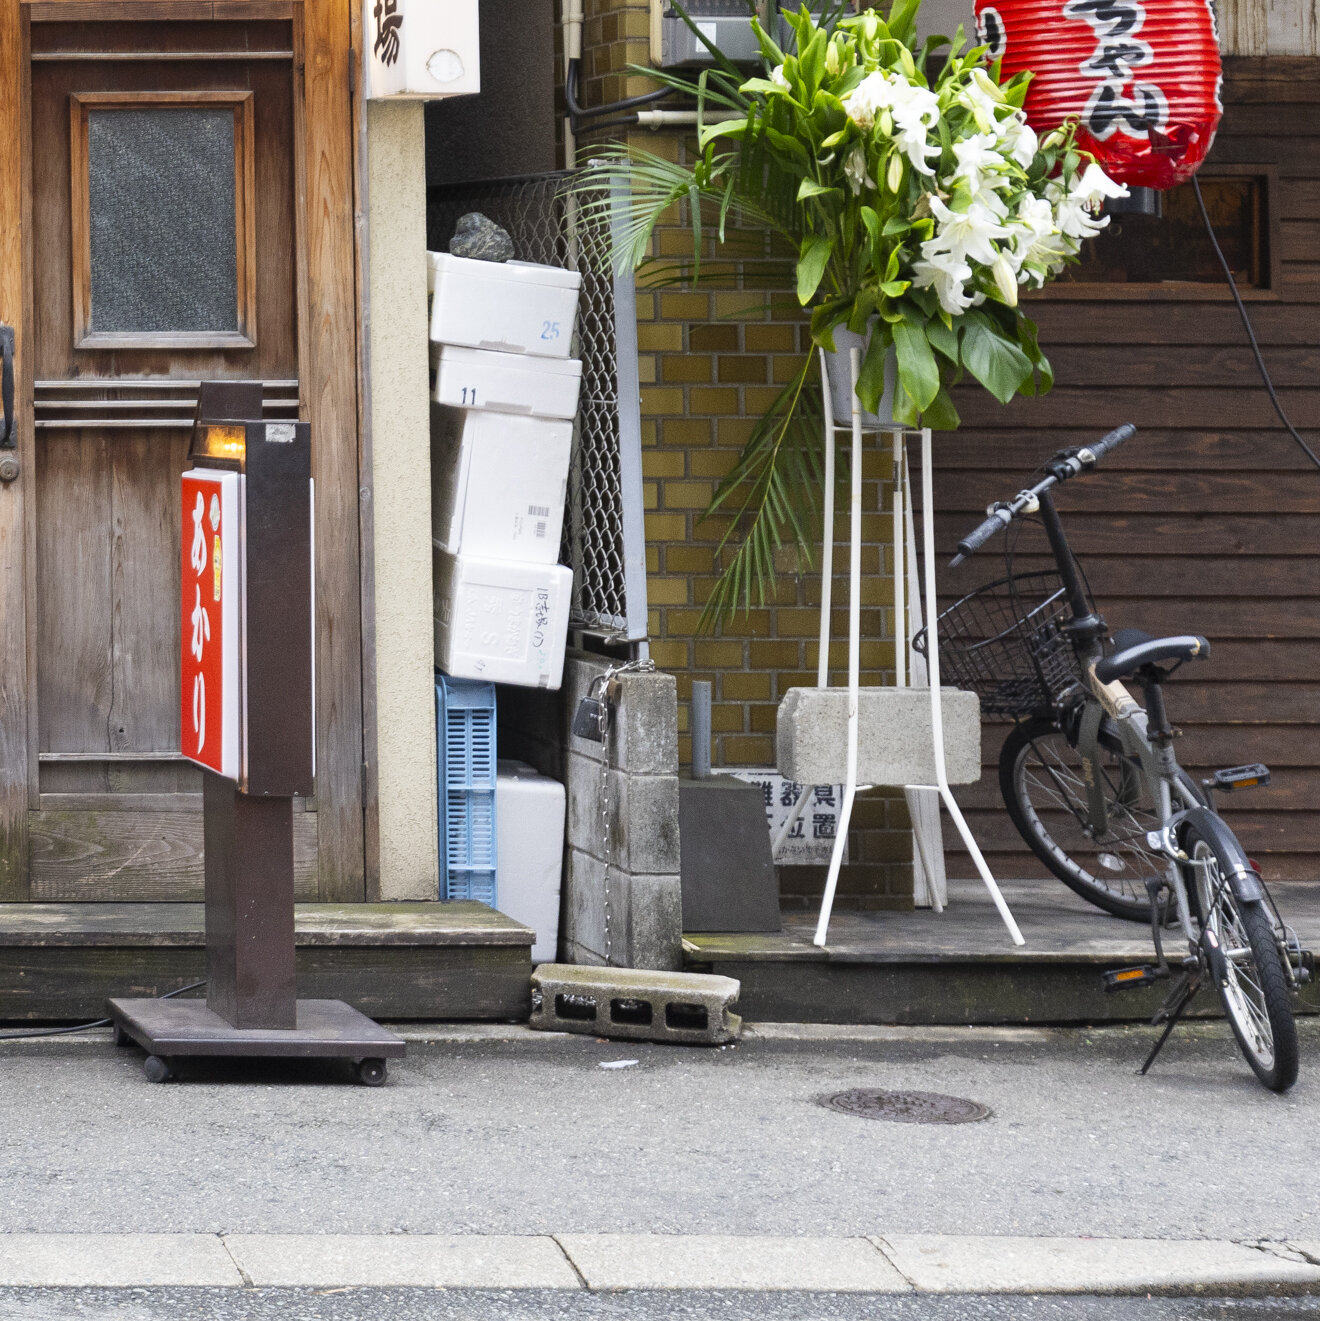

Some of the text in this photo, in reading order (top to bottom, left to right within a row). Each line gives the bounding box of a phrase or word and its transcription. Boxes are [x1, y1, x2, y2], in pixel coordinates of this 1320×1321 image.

[541, 320, 561, 340] 25
[462, 387, 477, 405] 11
[191, 490, 210, 755] あかり
